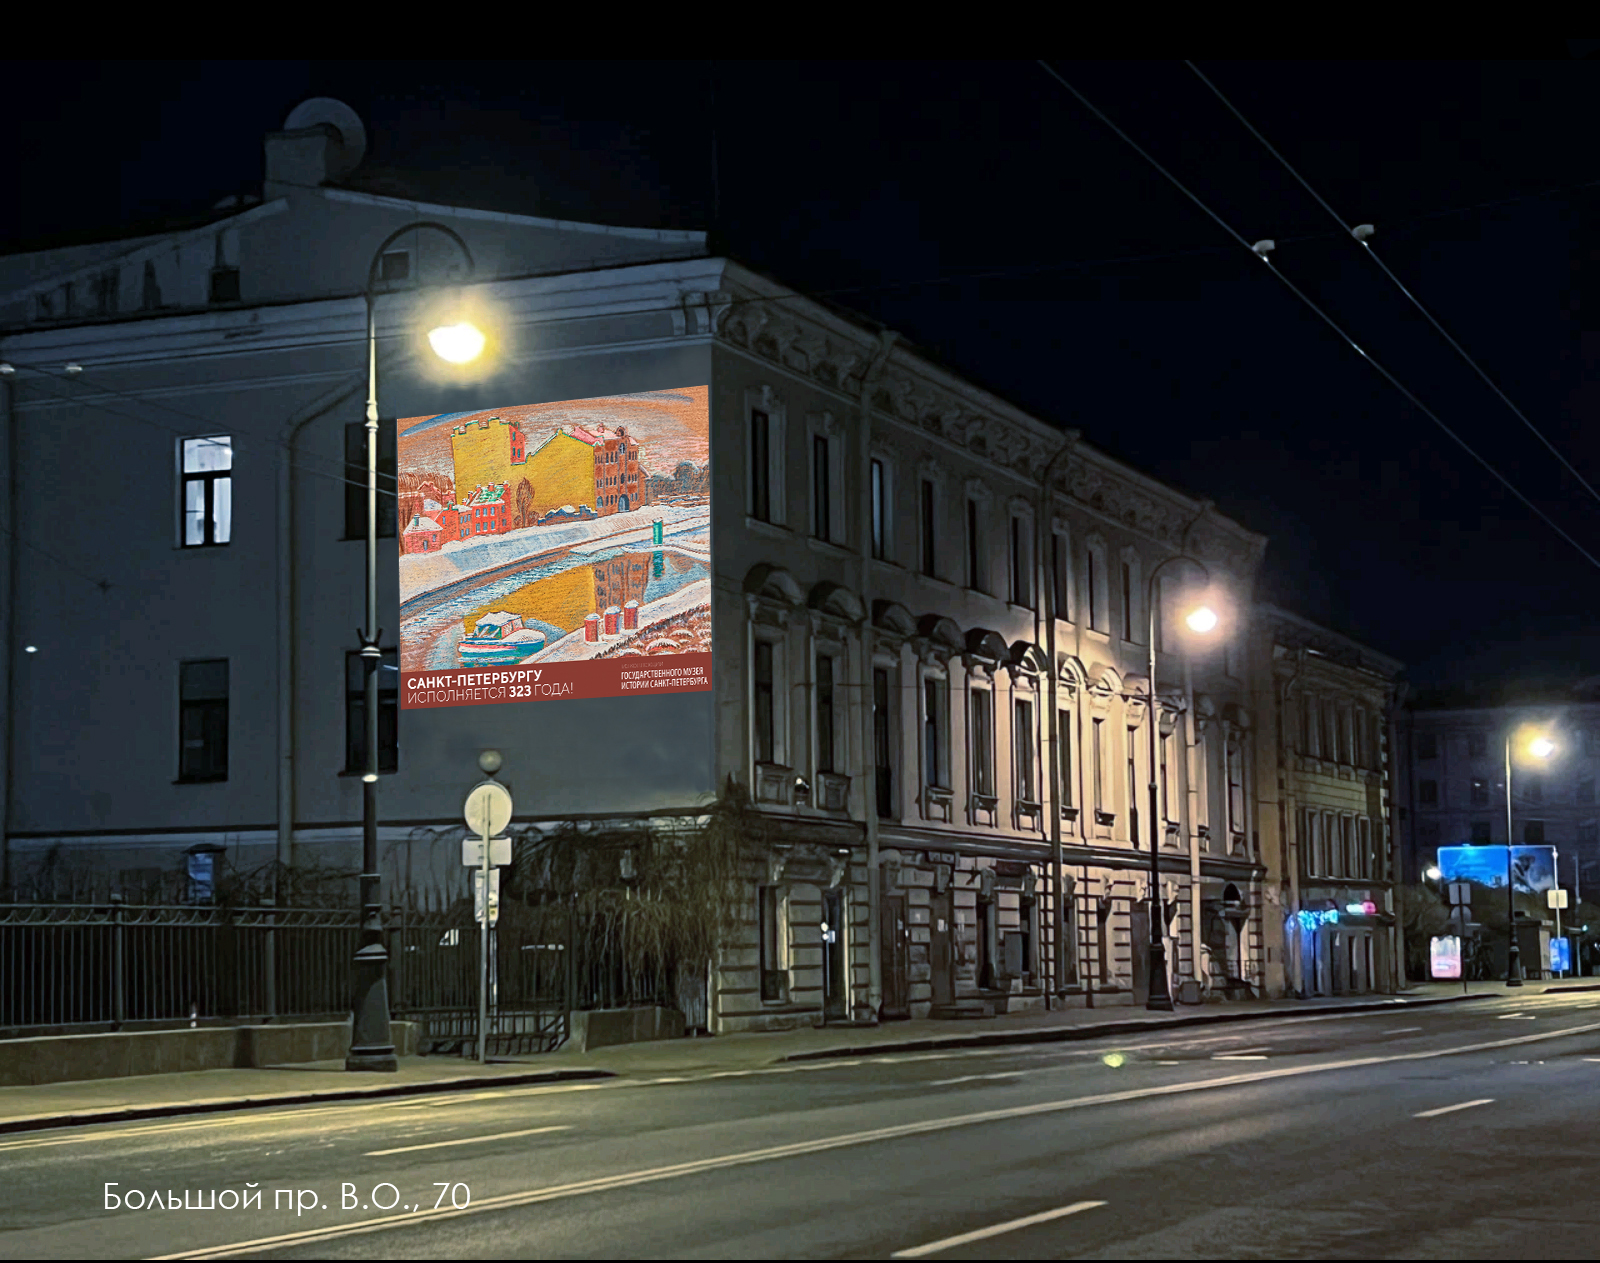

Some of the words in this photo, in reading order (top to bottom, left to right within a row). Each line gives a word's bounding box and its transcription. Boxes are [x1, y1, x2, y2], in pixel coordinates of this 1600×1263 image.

[407, 669, 542, 690] САНКТ-ПЕТЕРБУРГУ
[621, 668, 682, 680] ГОСУДАРСТВЕННОГО
[683, 666, 704, 676] МУЗЕЯ
[621, 680, 650, 690] ИСТОРИИ
[650, 676, 708, 688] САНКТ-ПЕТЕРБУРГА
[408, 686, 506, 704] ИСПОЛНЯЕТСЯ
[508, 685, 532, 698] 323
[534, 682, 573, 697] ГОДА!
